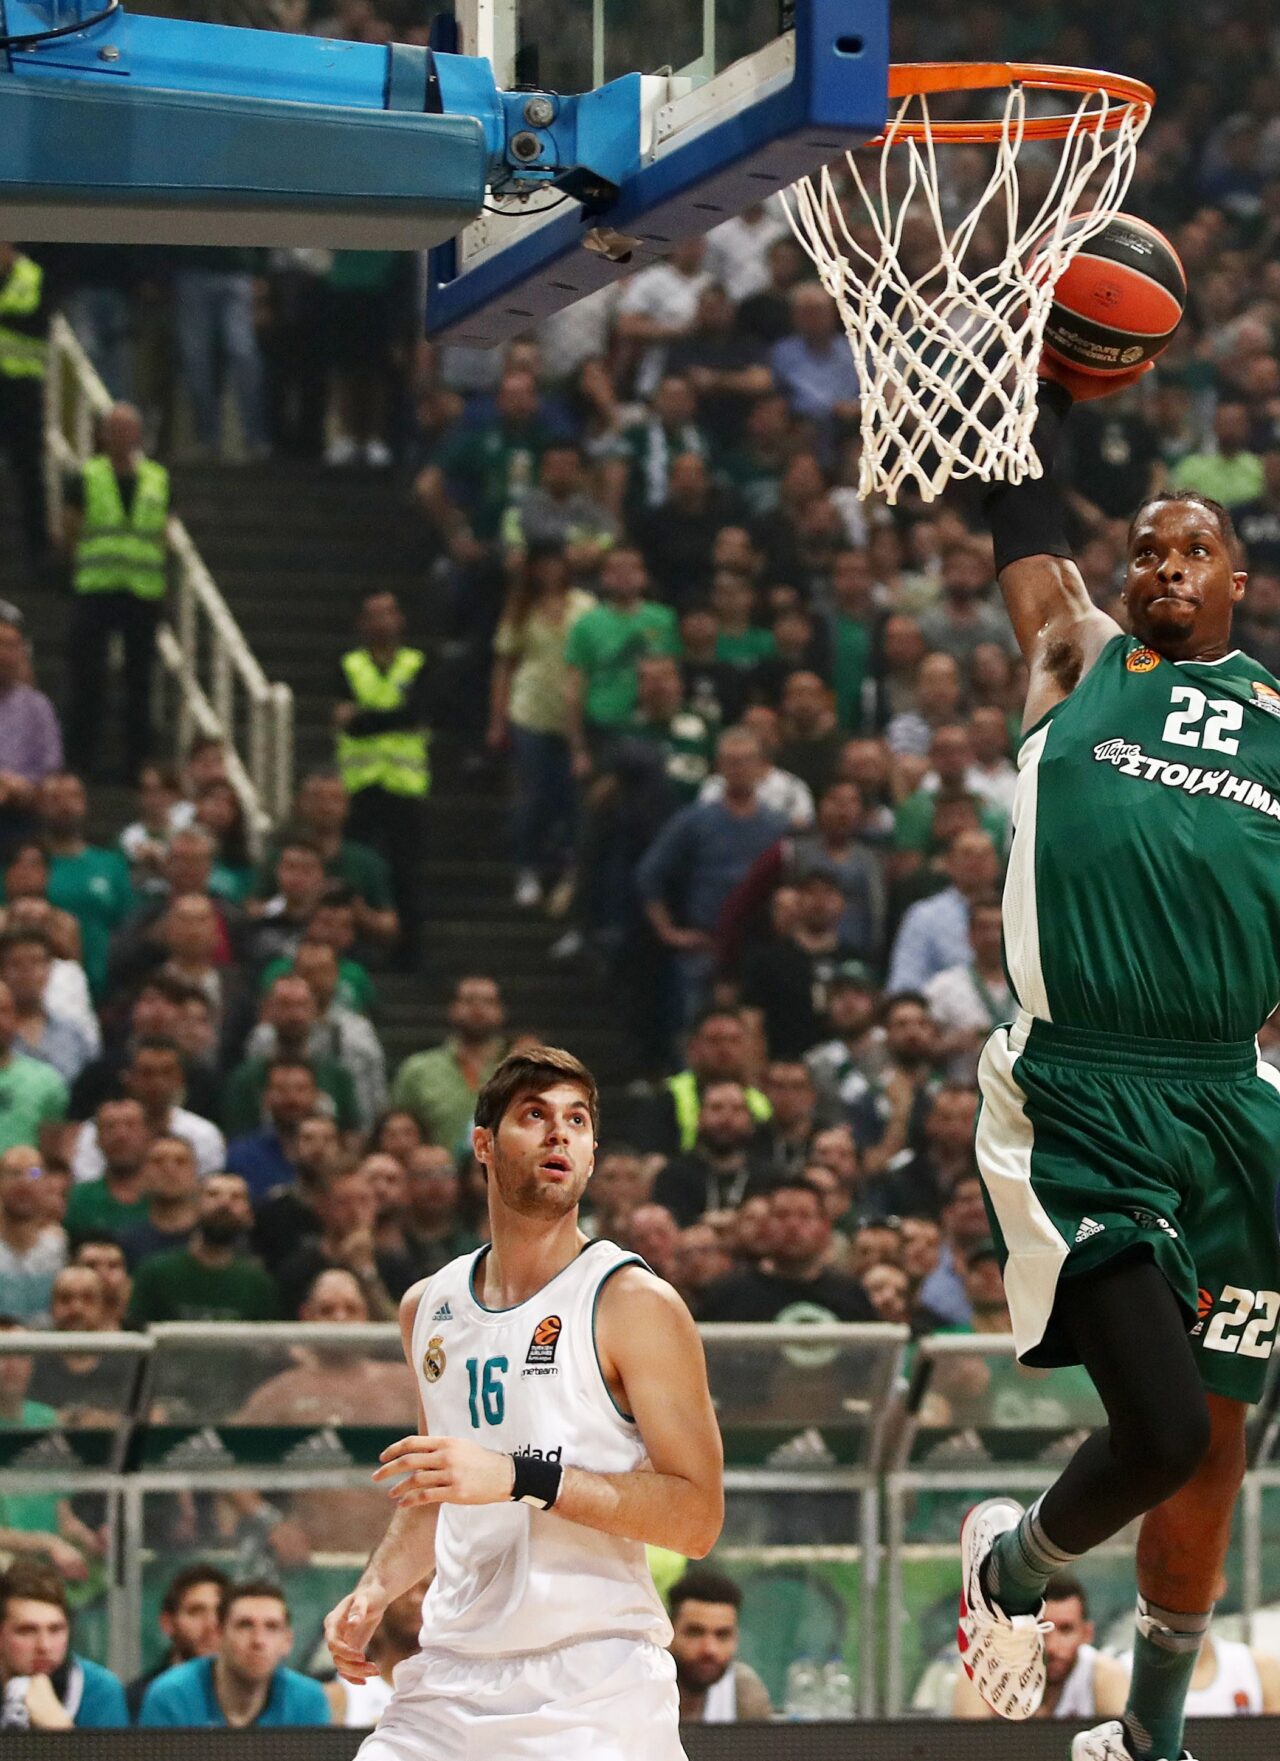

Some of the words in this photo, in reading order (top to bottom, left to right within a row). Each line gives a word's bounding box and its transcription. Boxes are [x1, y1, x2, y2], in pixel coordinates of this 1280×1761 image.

[1162, 686, 1243, 756] 22
[1075, 1223, 1105, 1243] adidas
[466, 1355, 508, 1429] 16
